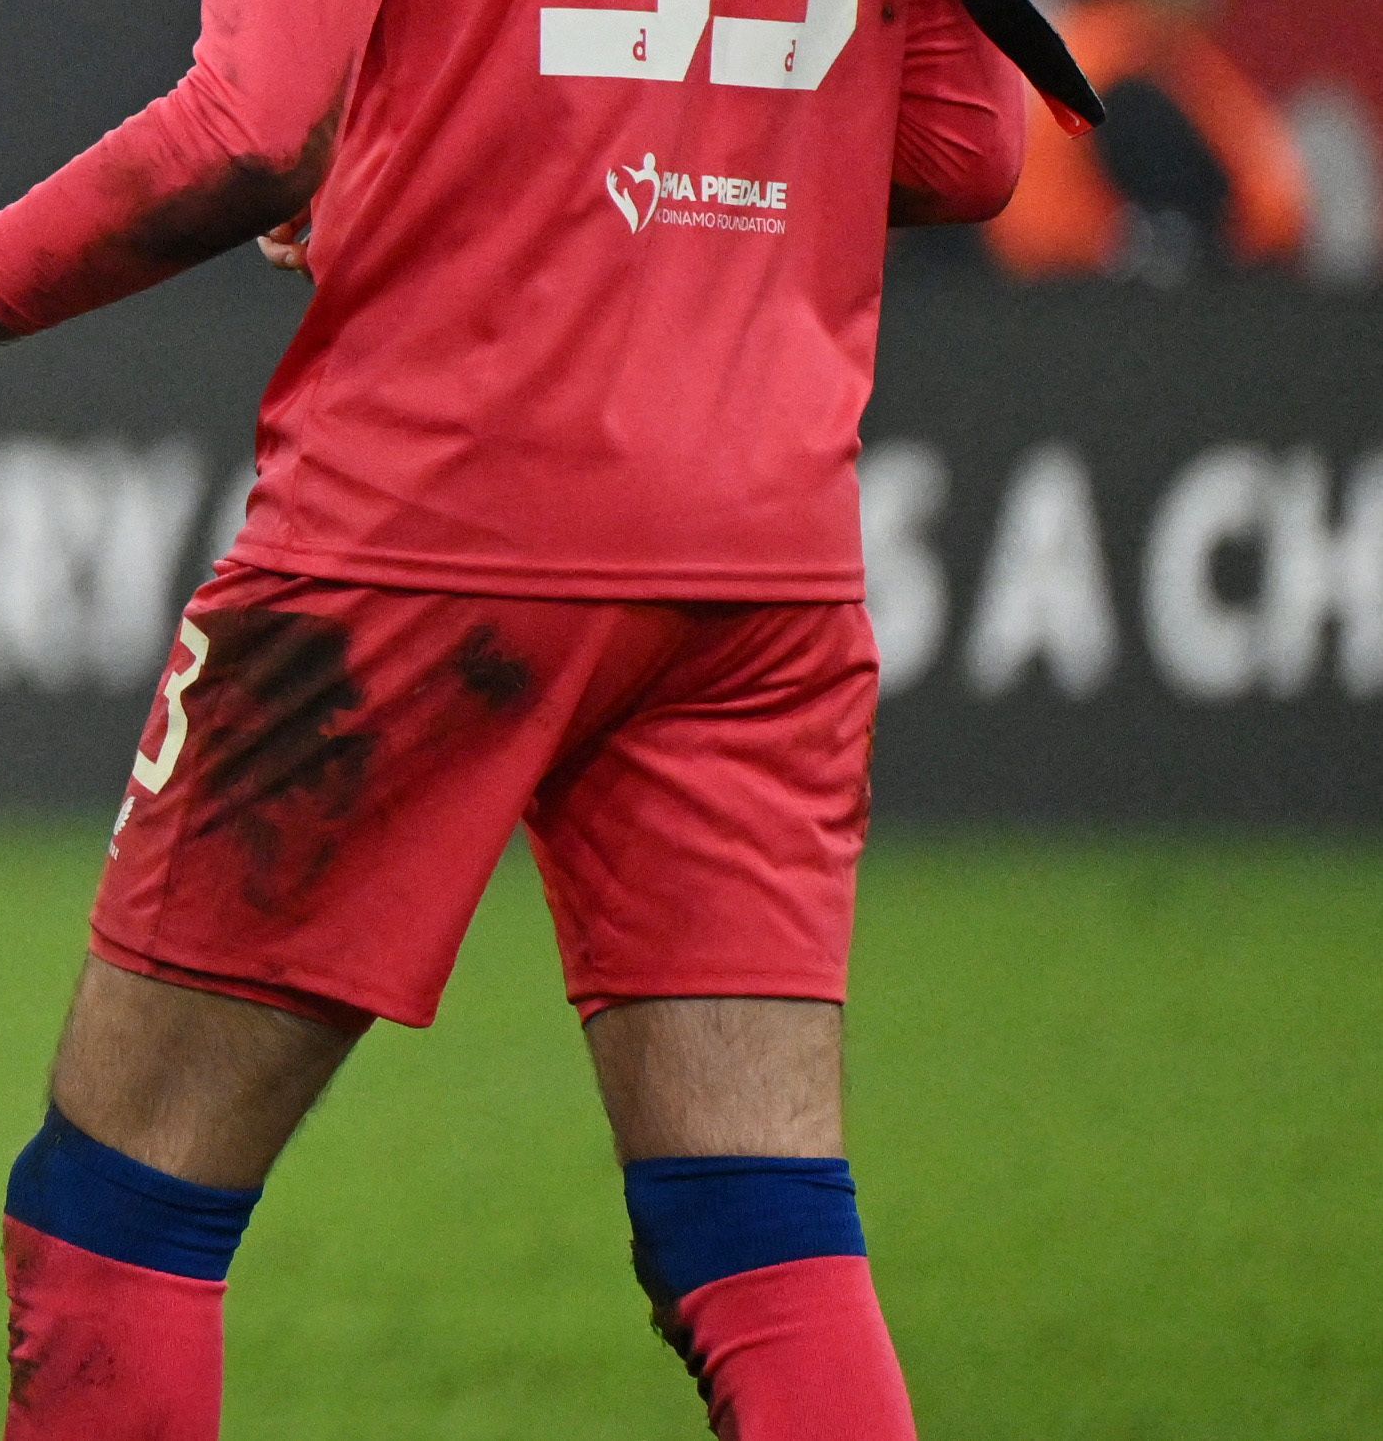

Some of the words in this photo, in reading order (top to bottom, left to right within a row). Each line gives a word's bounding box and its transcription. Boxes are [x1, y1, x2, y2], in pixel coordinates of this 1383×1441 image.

[701, 175, 788, 209] PREDAJE
[662, 208, 715, 228] DINAMO
[717, 212, 786, 234] FOUNDATION
